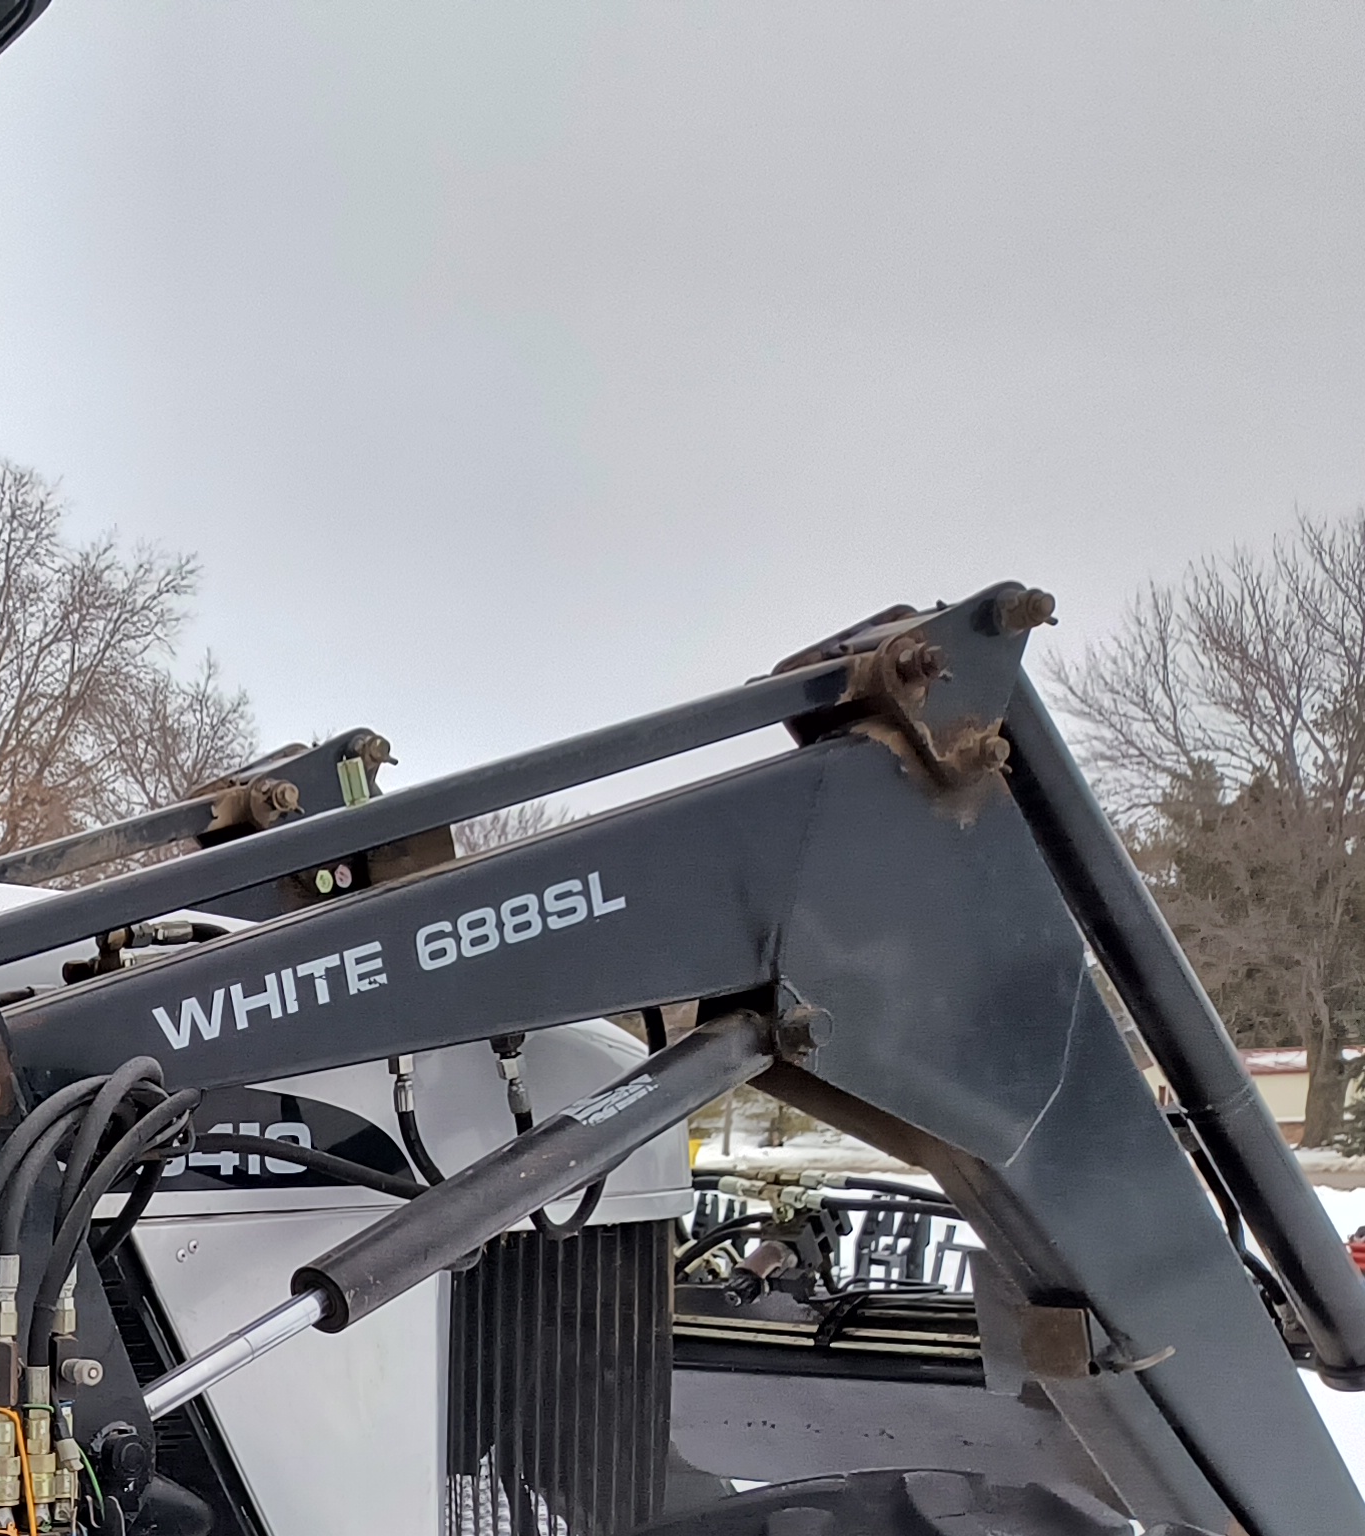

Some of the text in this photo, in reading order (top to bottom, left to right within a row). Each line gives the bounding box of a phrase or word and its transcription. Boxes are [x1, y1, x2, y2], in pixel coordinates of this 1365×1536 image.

[151, 871, 627, 1051] WHITE 688SL
[135, 1121, 312, 1177] 410
